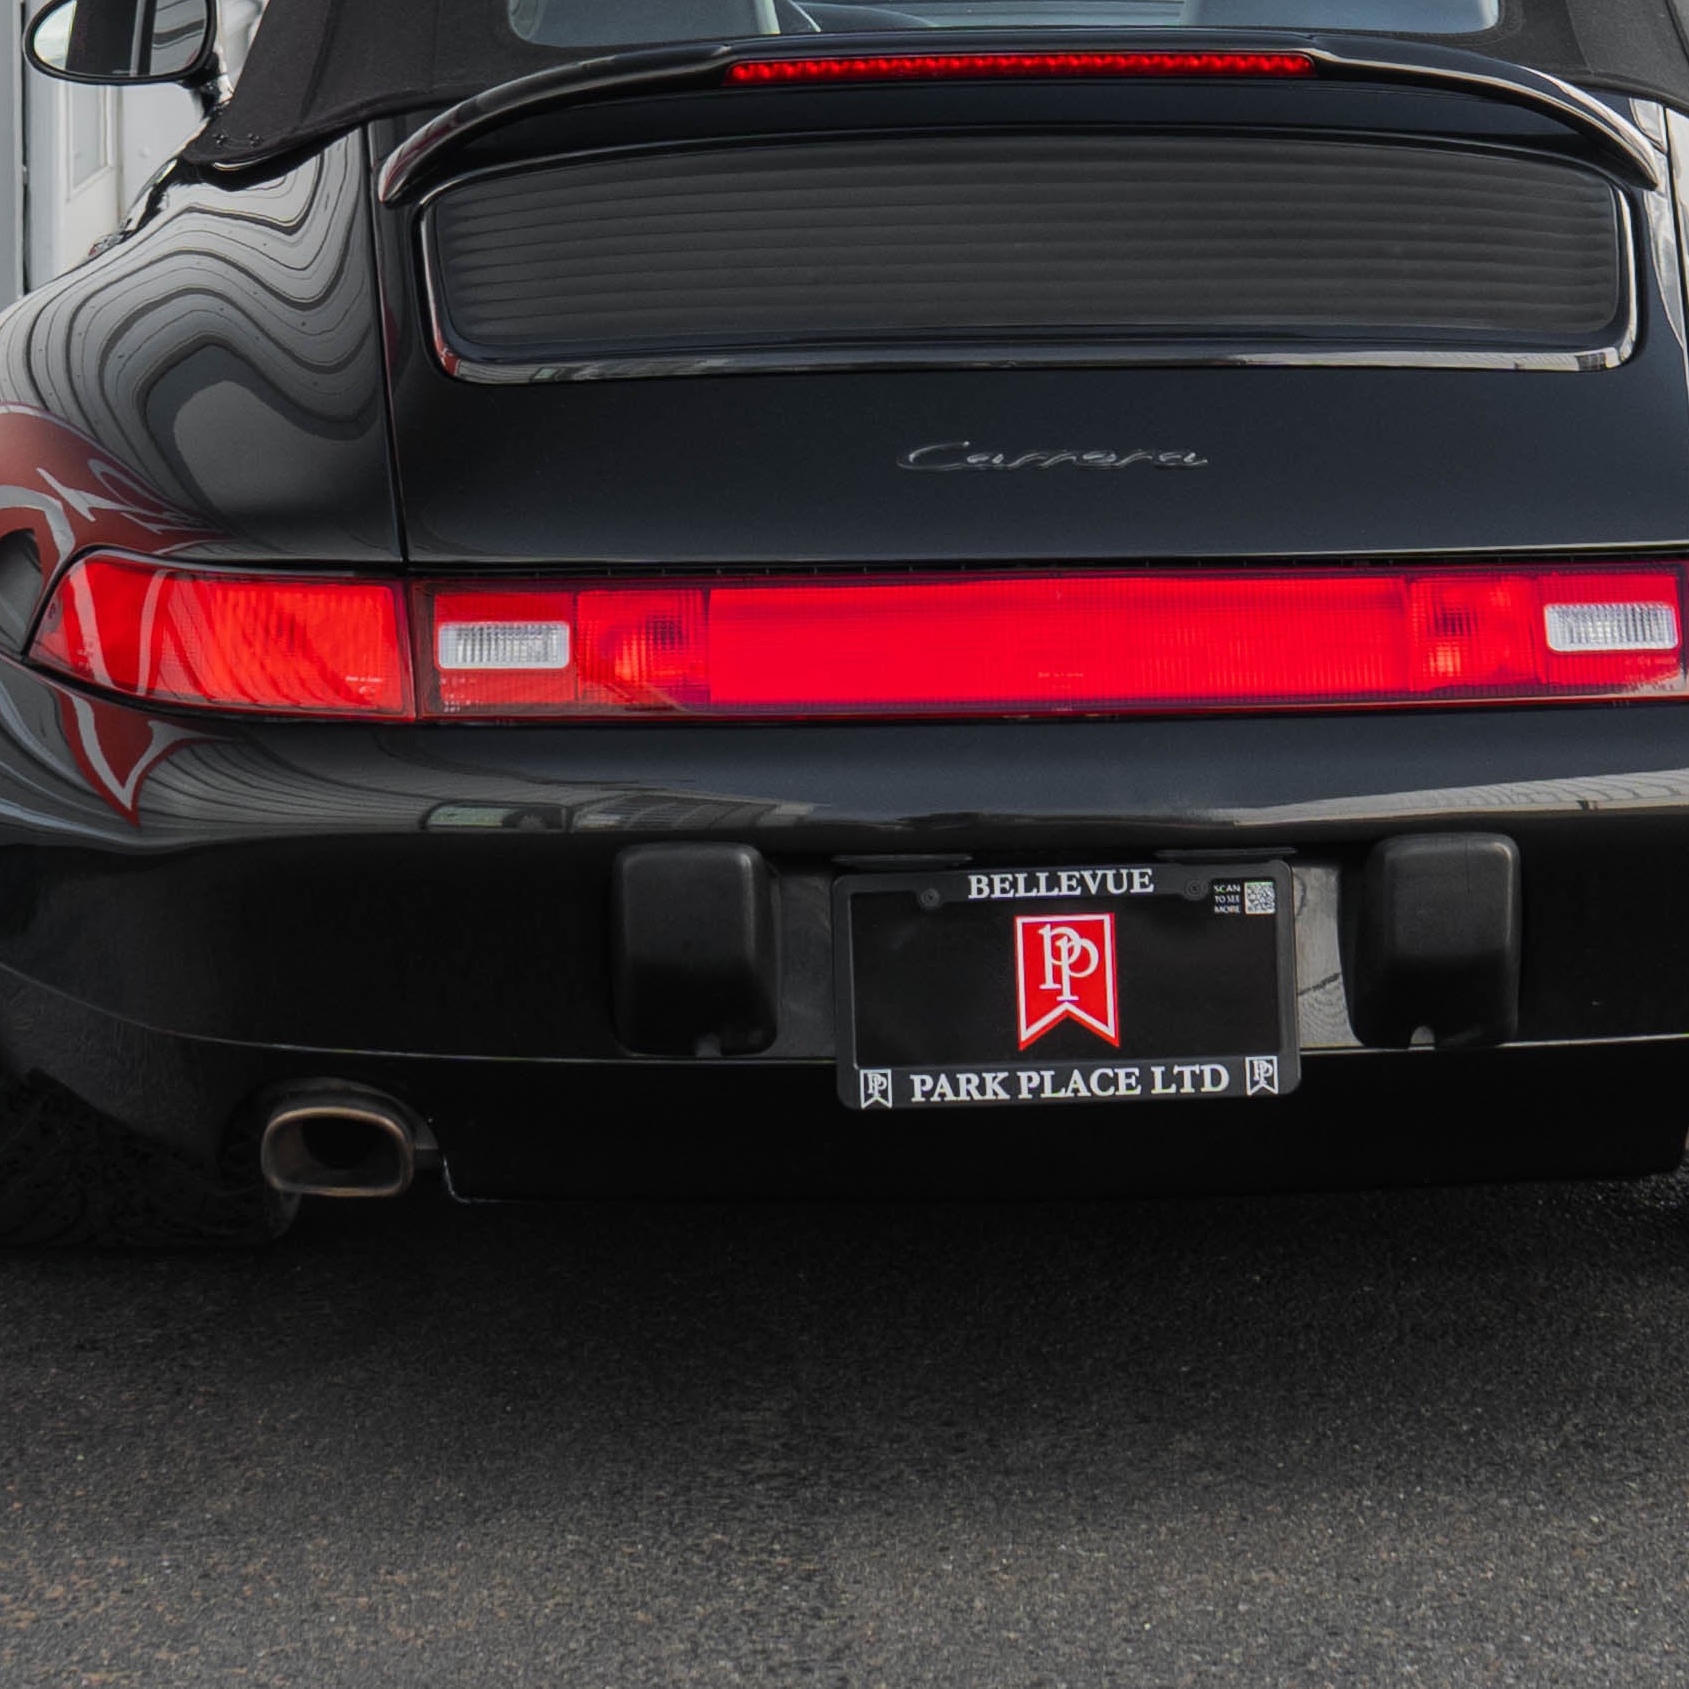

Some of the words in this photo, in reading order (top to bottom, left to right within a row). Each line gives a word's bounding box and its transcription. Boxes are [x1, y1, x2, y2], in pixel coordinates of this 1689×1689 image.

[896, 440, 1208, 471] Carrera
[968, 868, 1155, 900] BELLEVUE
[1213, 884, 1241, 893] SCAN
[910, 1071, 1010, 1102] PARK
[1017, 1068, 1141, 1099] PLACE
[1150, 1064, 1230, 1093] LTD
